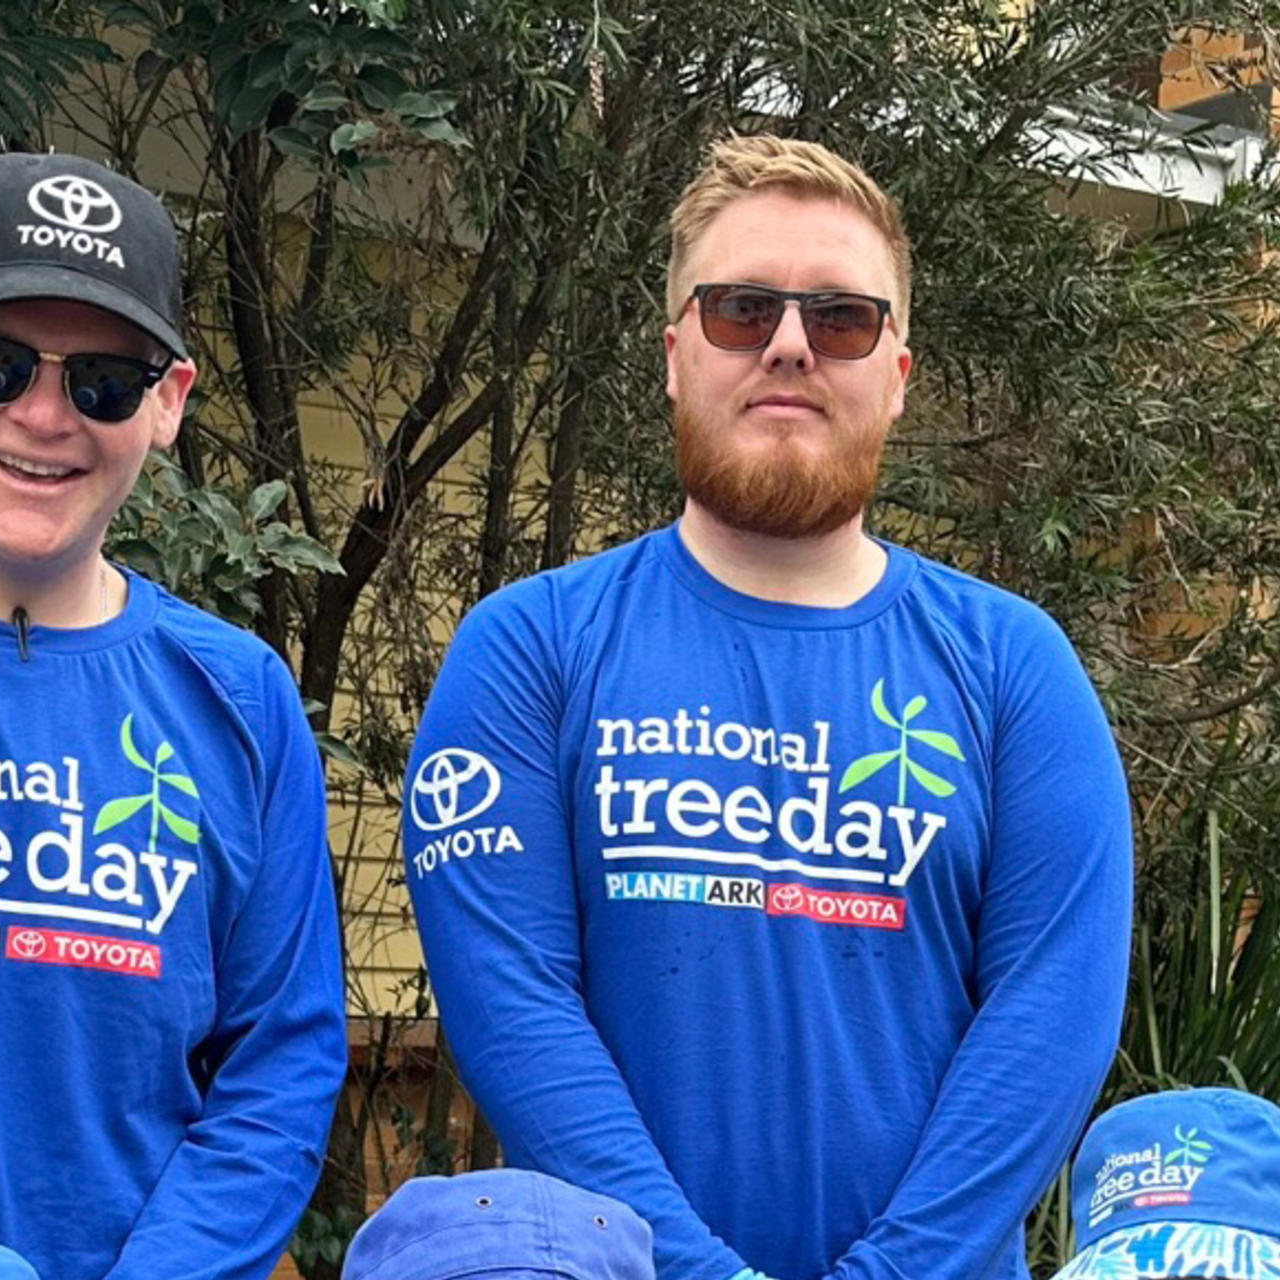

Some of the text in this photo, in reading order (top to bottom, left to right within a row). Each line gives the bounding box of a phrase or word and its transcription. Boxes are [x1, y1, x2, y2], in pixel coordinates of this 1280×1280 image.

[17, 225, 125, 268] TOYOTA
[597, 706, 830, 772] national
[413, 825, 523, 879] TOYOTA
[595, 766, 946, 887] tree day
[26, 812, 198, 935] day
[607, 873, 899, 923] PLANET ARK TOYOTA
[55, 936, 157, 971] TOYOTA
[1138, 1161, 1205, 1191] day
